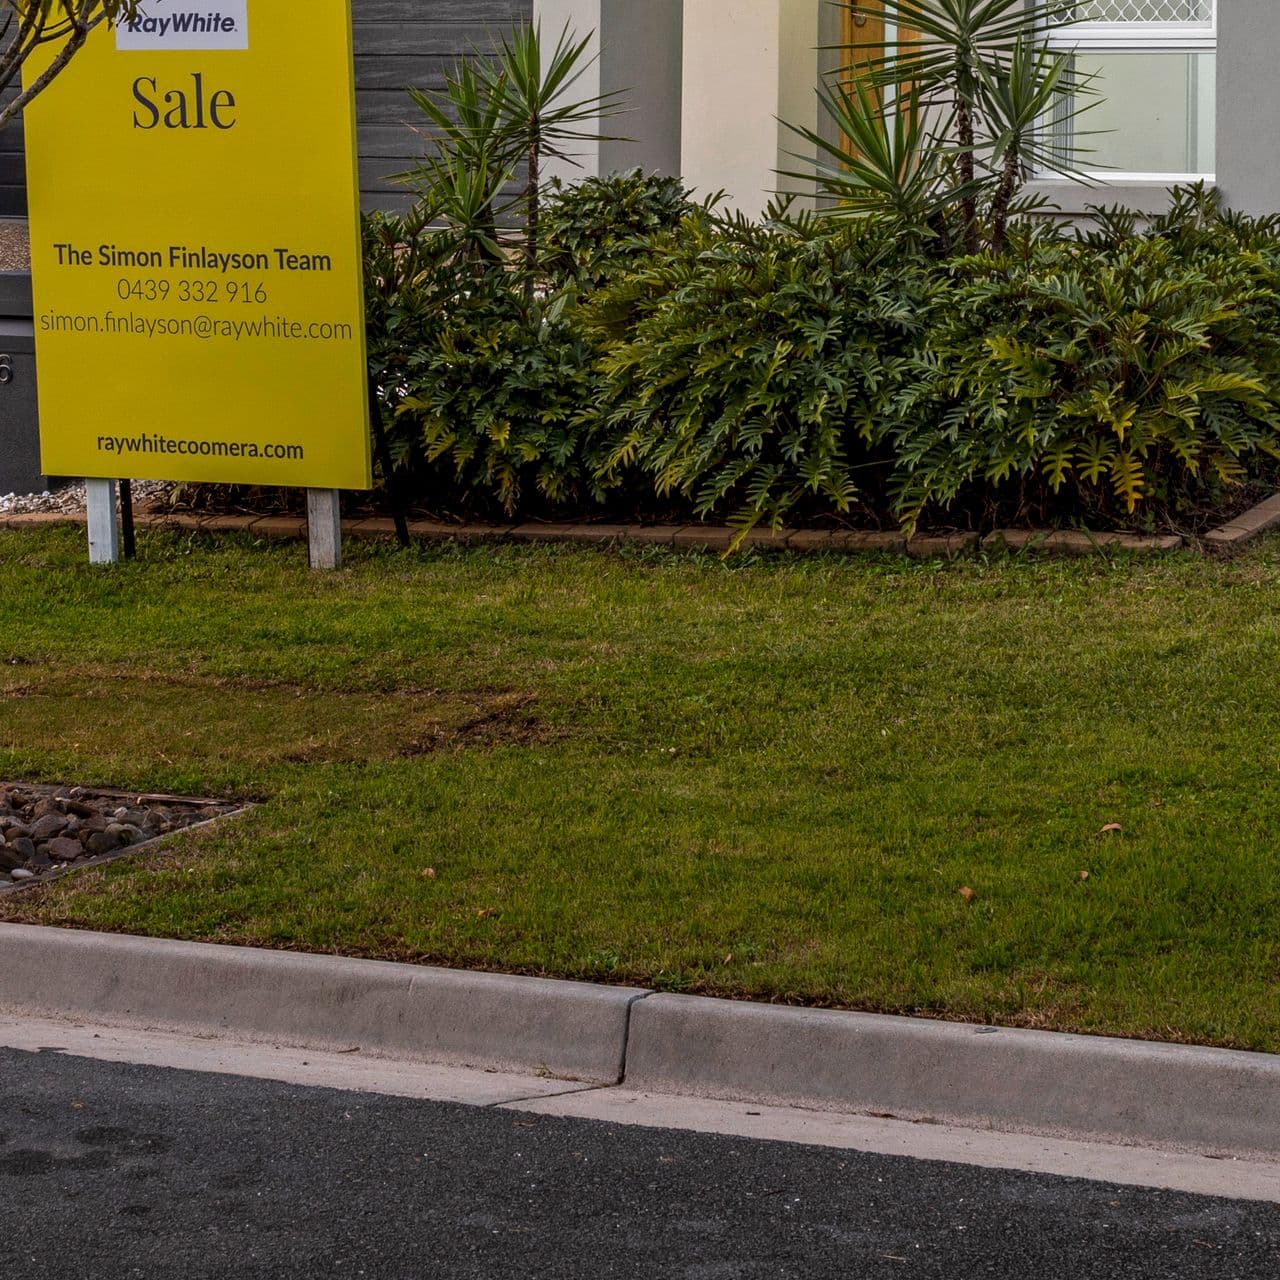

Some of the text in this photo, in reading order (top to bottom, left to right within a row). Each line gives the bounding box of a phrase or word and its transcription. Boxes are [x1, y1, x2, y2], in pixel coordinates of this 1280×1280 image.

[132, 72, 237, 129] Sale
[53, 243, 332, 273] The Simon Finlayson Team
[117, 278, 267, 304] 0439 332 916
[41, 310, 352, 341] simon.finlayson@raywhite.com
[97, 433, 304, 460] raywhitecoomera.com
